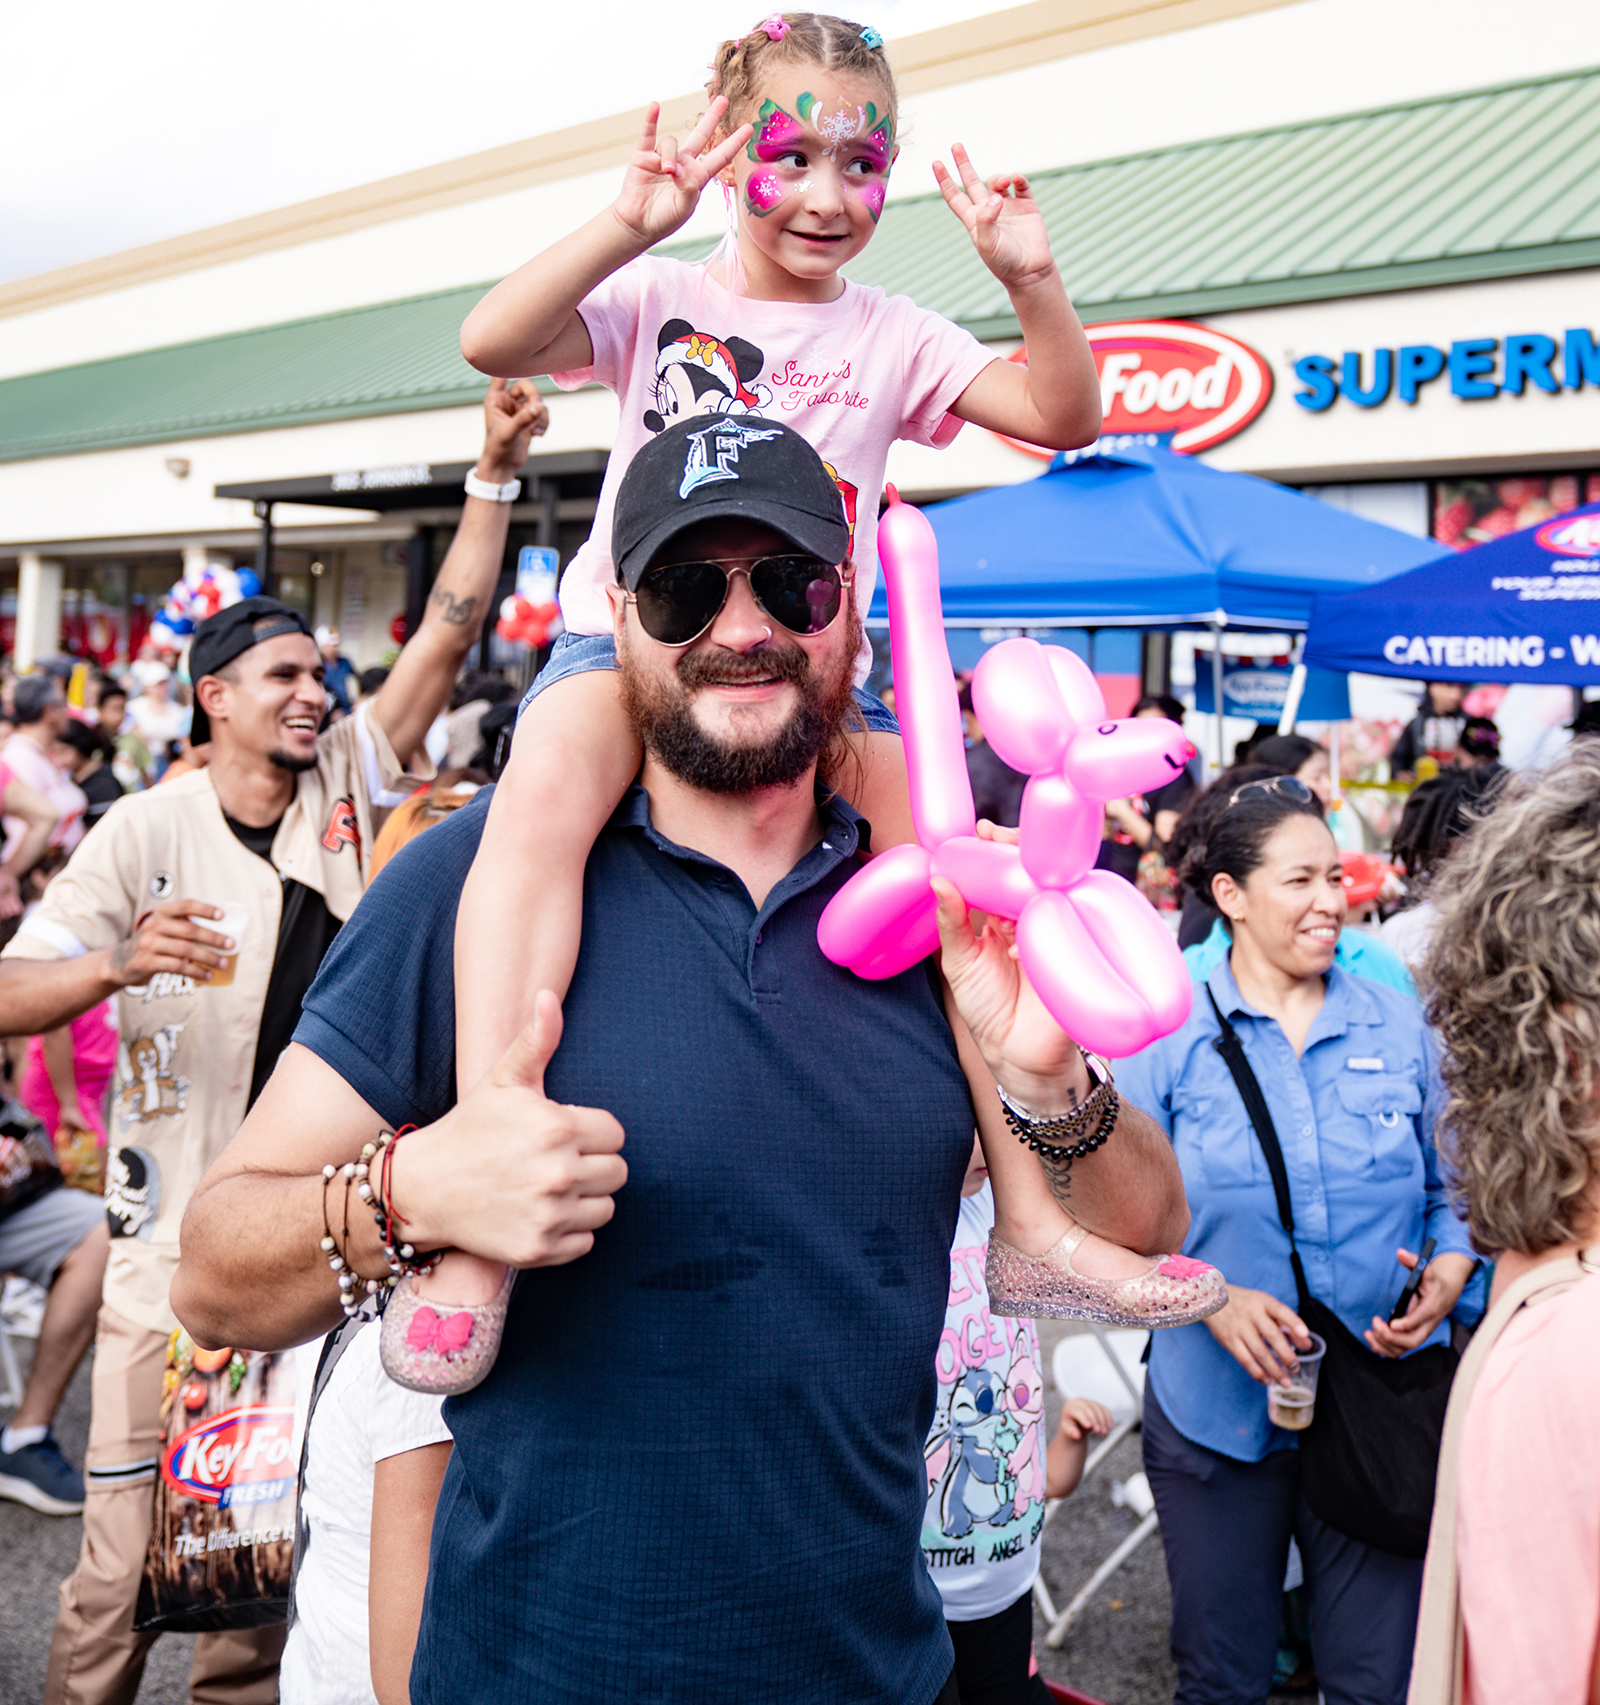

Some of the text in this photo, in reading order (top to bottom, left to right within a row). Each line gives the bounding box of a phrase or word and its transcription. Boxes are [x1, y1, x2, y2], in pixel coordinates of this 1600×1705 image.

[780, 390, 869, 411] Favorite
[1100, 352, 1234, 418] Food
[1383, 635, 1545, 668] CATERING
[176, 1432, 244, 1485] Key
[222, 1480, 284, 1504] FRESH
[175, 1532, 206, 1556] The
[207, 1525, 280, 1552] Difference
[988, 1533, 1025, 1562] ANGEL
